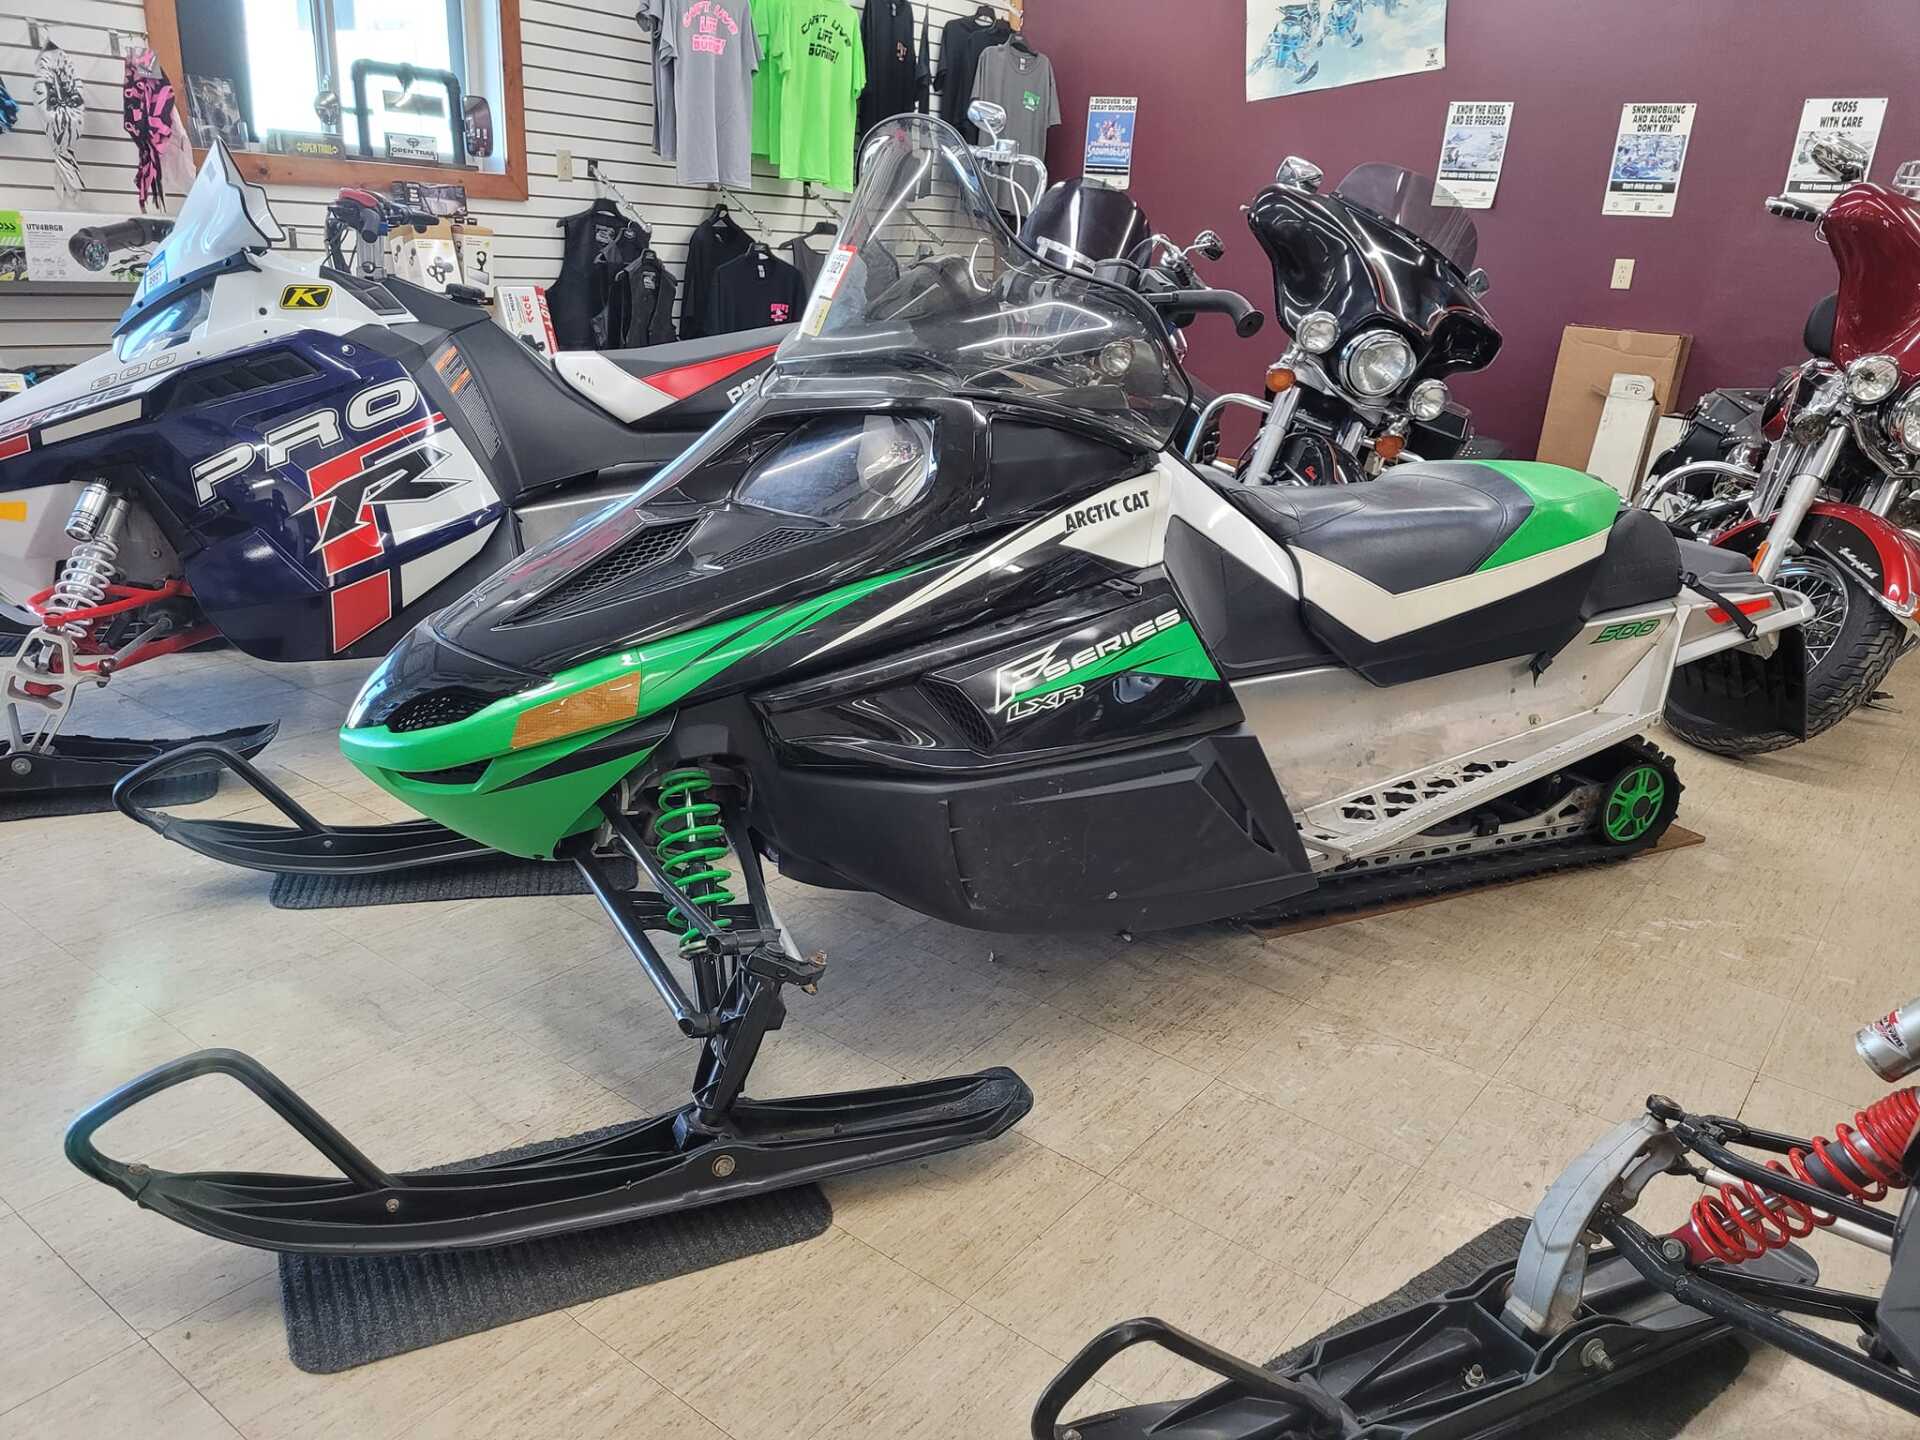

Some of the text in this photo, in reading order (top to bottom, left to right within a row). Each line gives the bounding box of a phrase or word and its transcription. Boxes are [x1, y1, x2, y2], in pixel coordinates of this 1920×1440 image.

[817, 27, 833, 44] LIFE
[1456, 104, 1506, 115] KNOW THE RISKS
[1632, 105, 1686, 114] SNOWMOBILING
[1832, 101, 1858, 113] CROSS
[1451, 115, 1506, 126] AND BE PREPARED
[1632, 115, 1681, 123] AND ALCOHOL
[1820, 116, 1863, 128] WITH CARE
[1637, 124, 1673, 133] DON'T MIX
[191, 377, 420, 508] PRO
[1064, 489, 1151, 533] ARCTIC CAT
[1590, 619, 1660, 645] 500
[1043, 608, 1183, 682] SERIES
[1006, 684, 1086, 723] LXR
